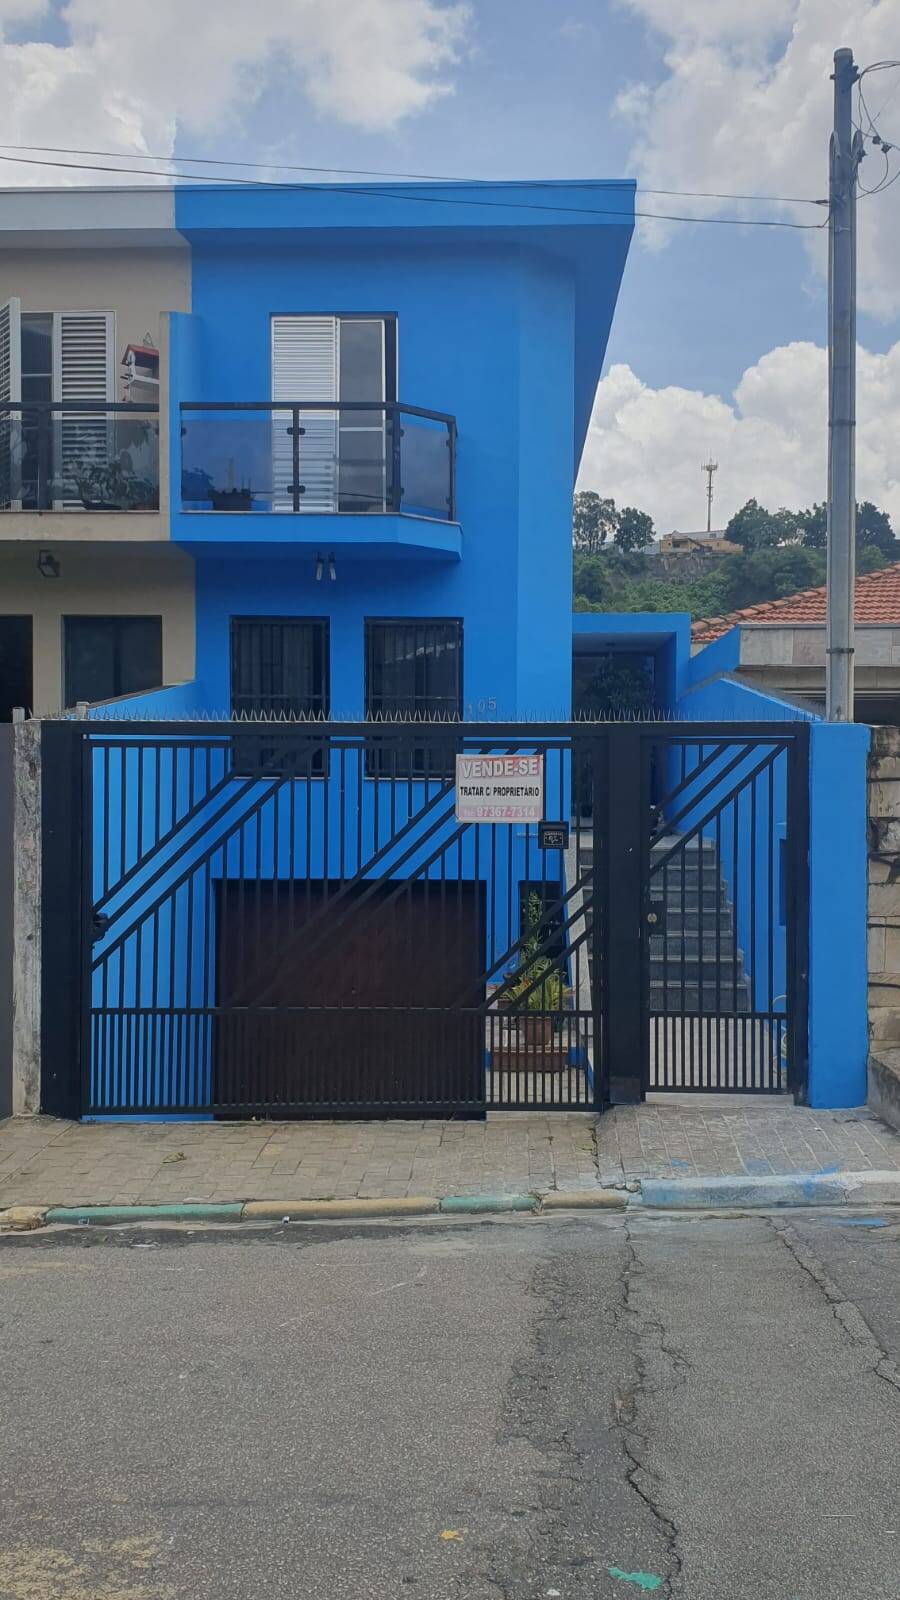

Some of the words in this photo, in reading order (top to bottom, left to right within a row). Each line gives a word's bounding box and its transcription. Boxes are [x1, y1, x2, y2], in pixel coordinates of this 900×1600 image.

[461, 758, 539, 778] VENDE-SE
[460, 786, 483, 796] TRATAR
[493, 785, 539, 796] PROPRIETÁRIO
[477, 807, 535, 817] 97367-7314
